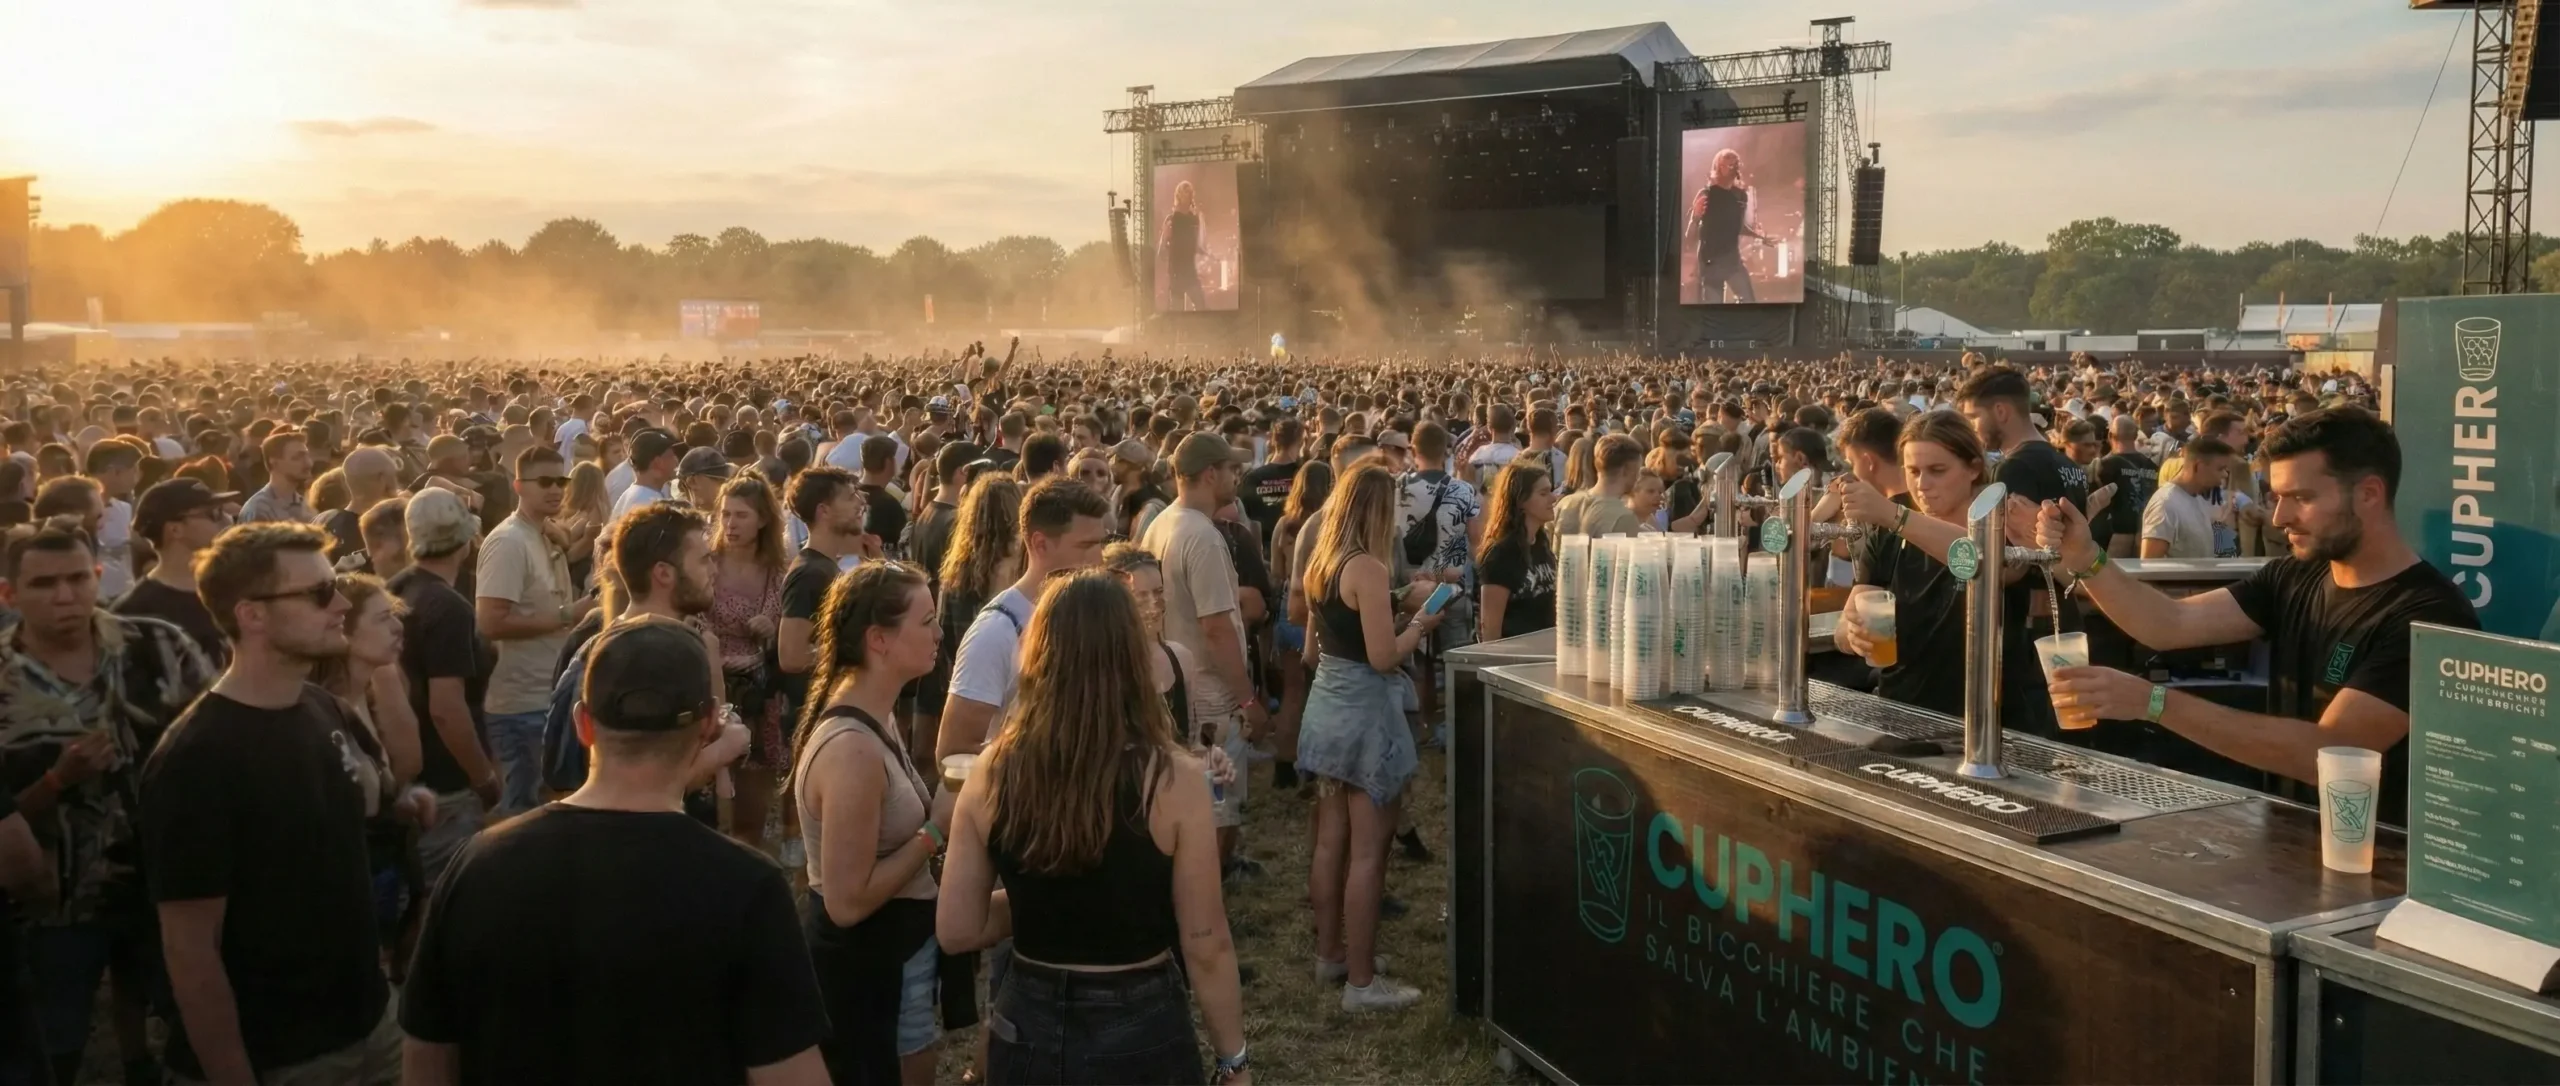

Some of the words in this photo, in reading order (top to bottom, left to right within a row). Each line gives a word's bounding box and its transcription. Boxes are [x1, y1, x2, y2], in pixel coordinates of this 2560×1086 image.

[2440, 658, 2547, 693] CUPHERO
[1859, 763, 2034, 813] CUPHERO
[1646, 934, 1735, 1006] SALVA
[1647, 894, 1668, 928] IL
[1688, 914, 1870, 1031] BICCHIERE
[1902, 1019, 1986, 1086] CHE
